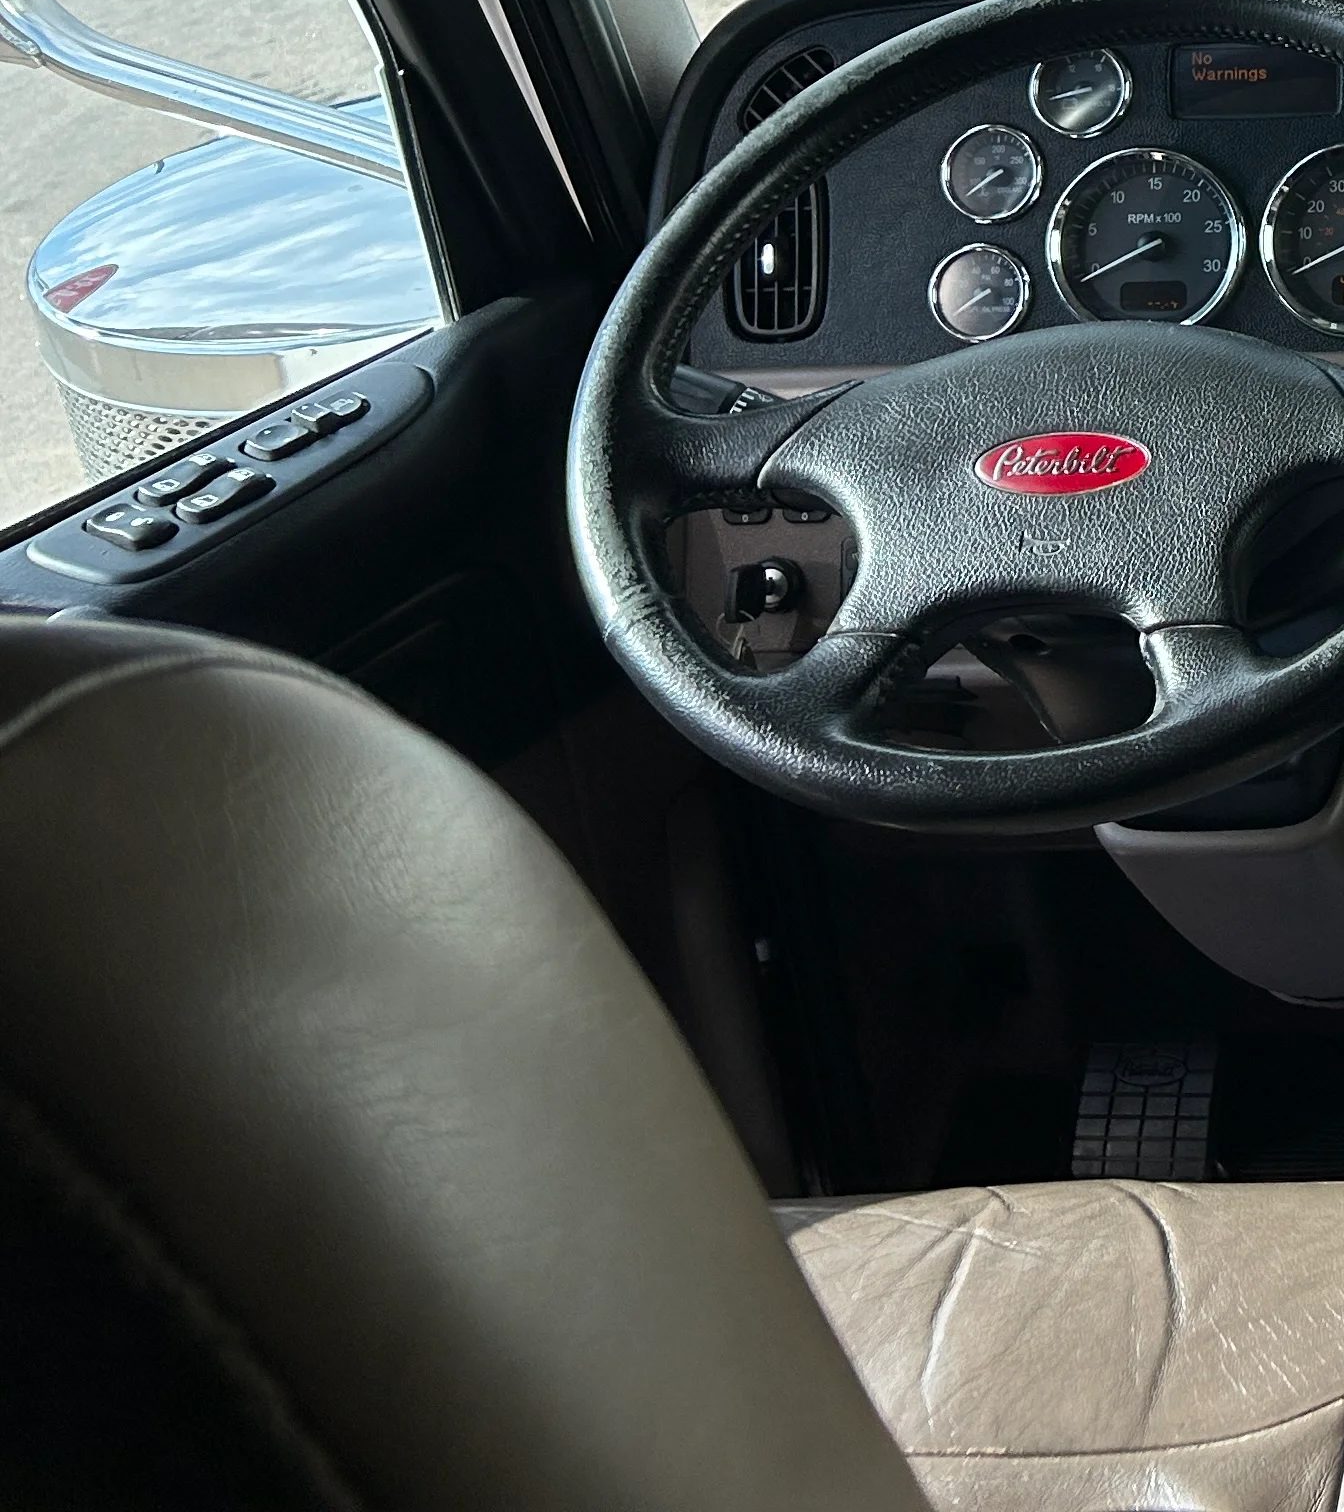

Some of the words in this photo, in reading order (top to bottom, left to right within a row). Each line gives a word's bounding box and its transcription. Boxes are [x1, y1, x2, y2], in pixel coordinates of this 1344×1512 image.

[1192, 51, 1212, 65] No
[1192, 66, 1268, 82] Warnings
[1148, 177, 1162, 190] 15
[1111, 191, 1125, 204] 10
[1183, 190, 1200, 202] 20
[1307, 200, 1324, 212] 20
[1128, 213, 1154, 225] RPM
[1163, 212, 1181, 224] 100
[1088, 224, 1097, 235] 5
[1204, 221, 1222, 233] 25
[1298, 227, 1312, 239] 10
[1203, 259, 1221, 272] 30
[992, 444, 1135, 481] Peterbilt
